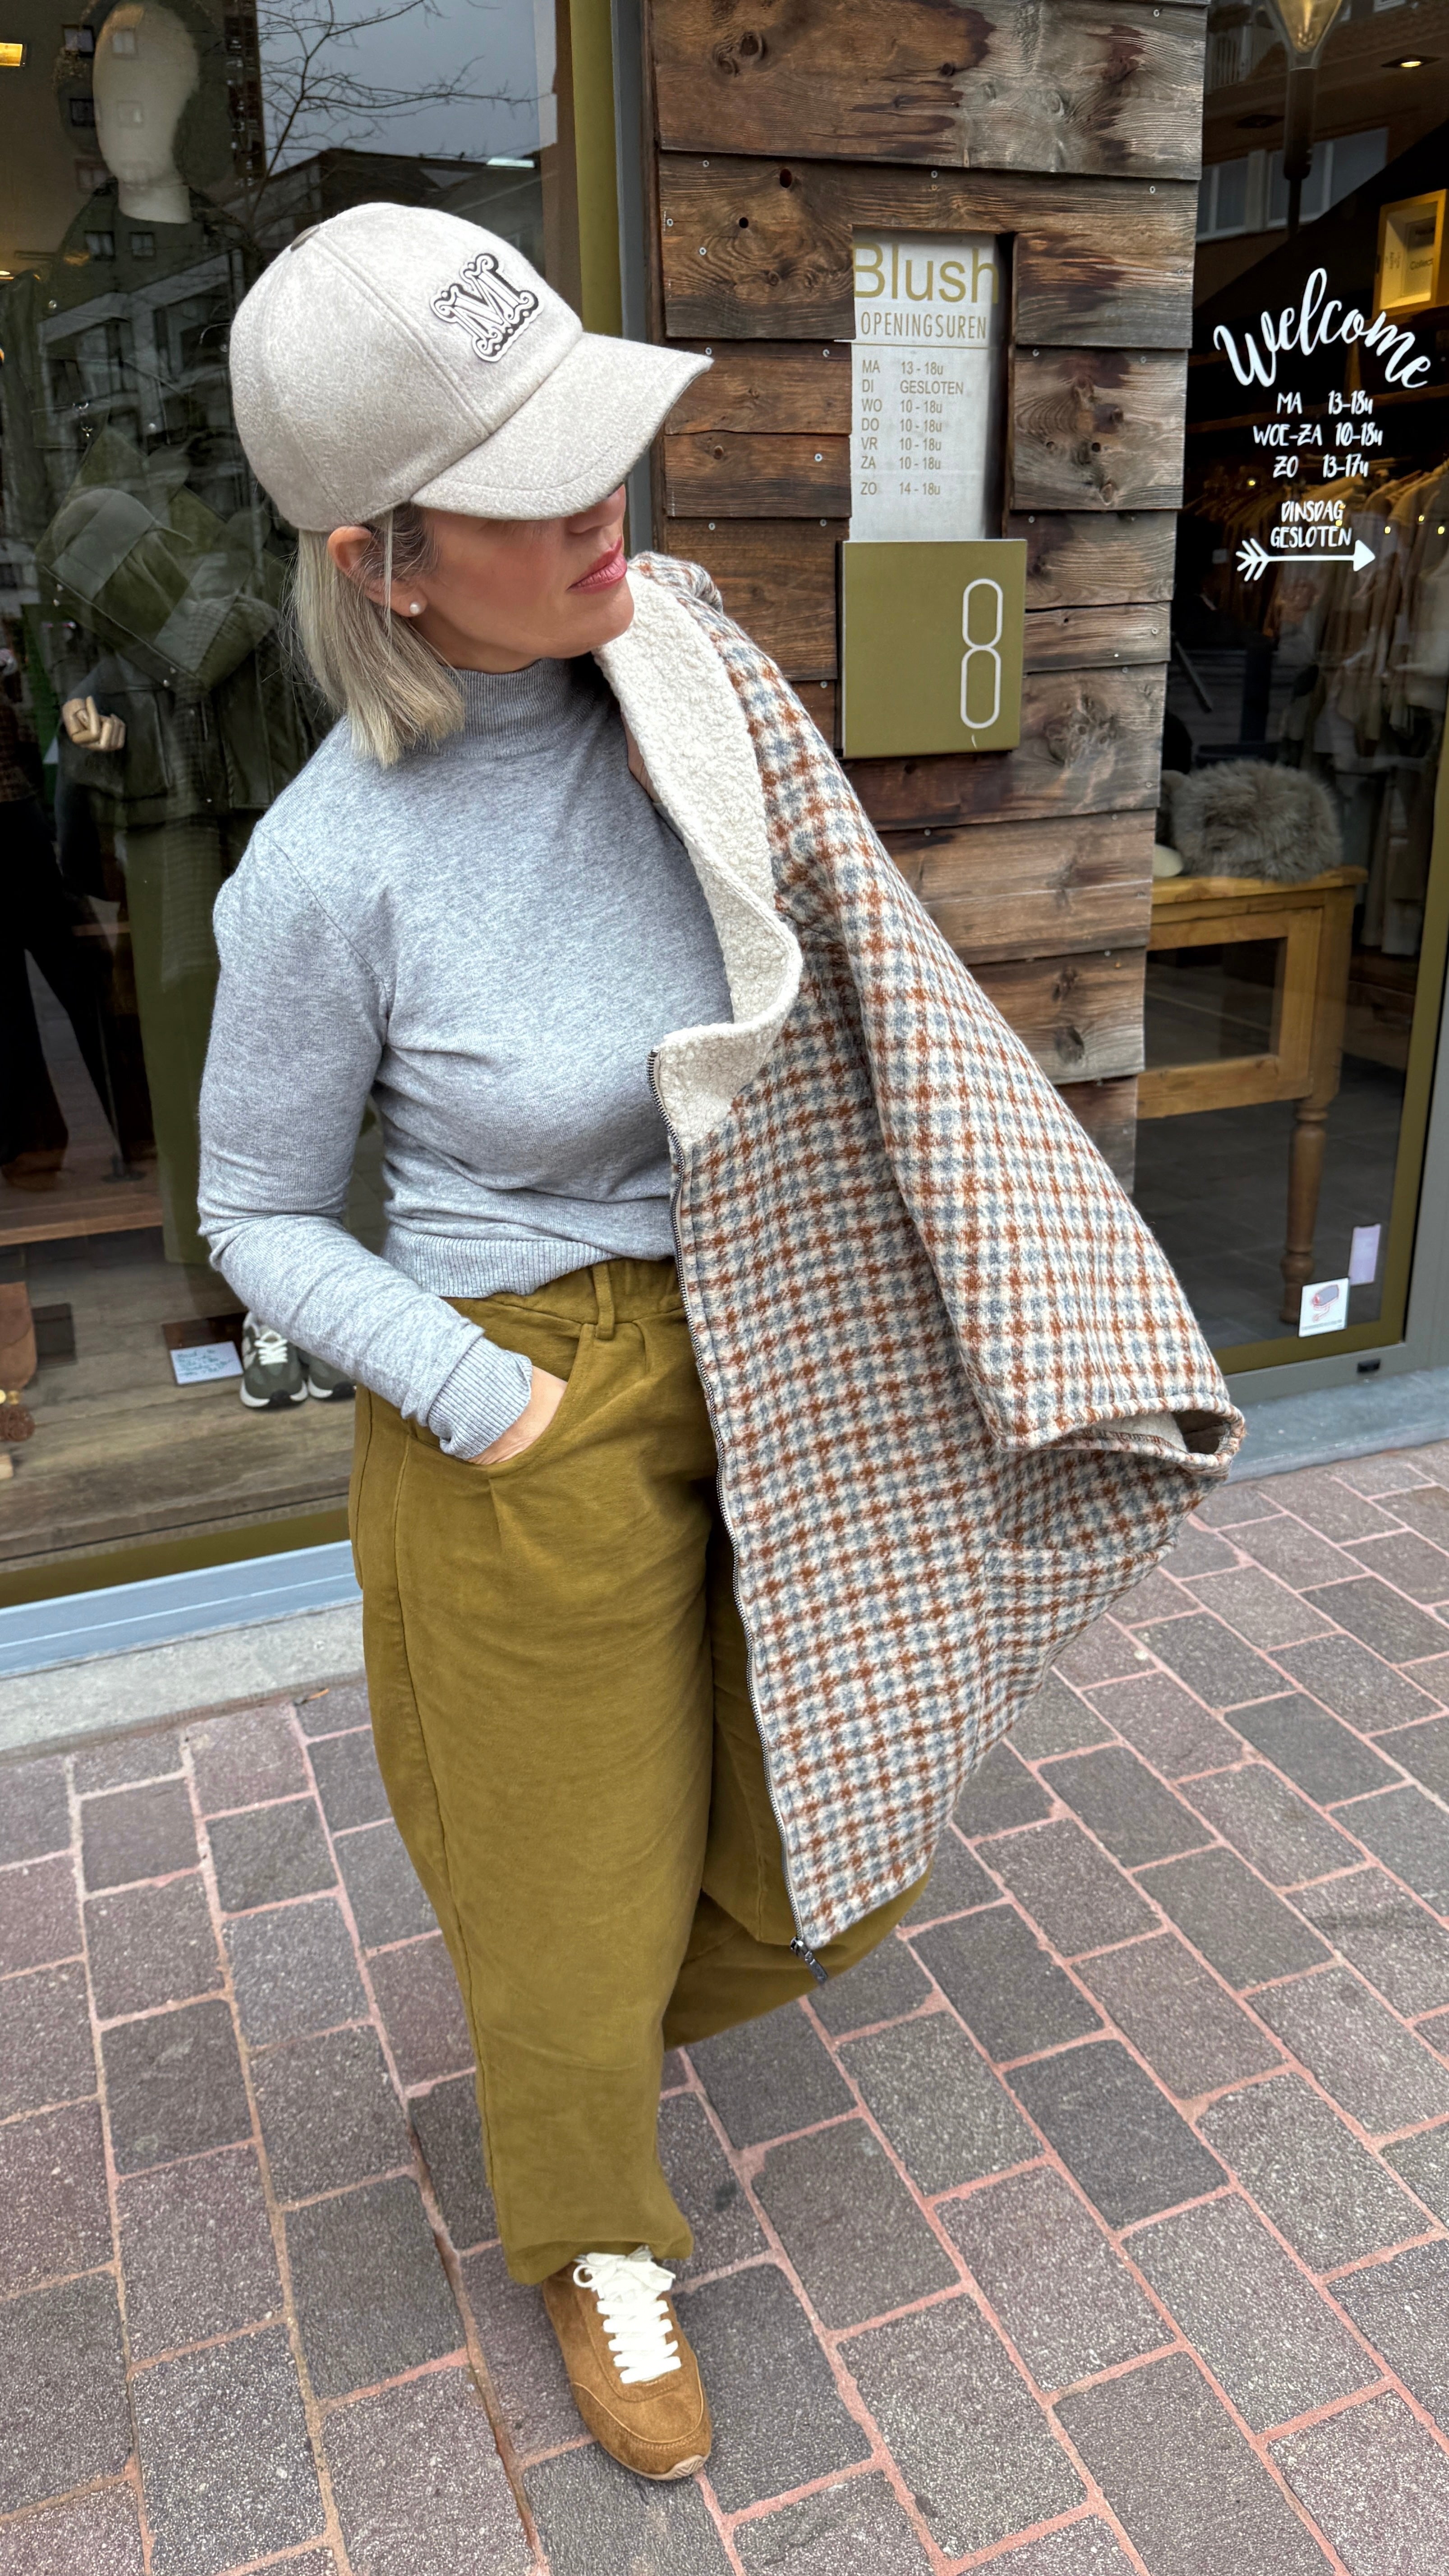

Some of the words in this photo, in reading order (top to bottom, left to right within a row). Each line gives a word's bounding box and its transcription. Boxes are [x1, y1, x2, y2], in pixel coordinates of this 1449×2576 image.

[852, 242, 999, 304] Blush
[433, 253, 539, 359] M
[860, 311, 986, 339] OPENINGSUREN
[1213, 268, 1431, 389] Welcome
[862, 359, 881, 374] MA
[901, 361, 914, 375] 13
[925, 362, 943, 375] 18u
[862, 379, 874, 393] DI
[900, 380, 964, 395] GESLOTEN
[861, 398, 883, 412] WO
[901, 399, 913, 413] 10
[925, 400, 943, 414] 18u
[1277, 391, 1303, 414] MA
[1329, 390, 1373, 414] 13-18u
[861, 418, 879, 431] DO
[900, 419, 912, 432] 10
[925, 419, 942, 433] 18u
[1253, 423, 1322, 446] WOE-ZA
[1336, 422, 1383, 446] 10-18u
[861, 437, 878, 450] VR
[900, 437, 912, 451] 10
[924, 437, 942, 451] 18u
[860, 455, 876, 469] ZA
[900, 456, 911, 470] 10
[924, 456, 941, 470] 18u
[1273, 455, 1299, 478] ZO
[1323, 453, 1369, 478] 13-17u
[860, 481, 878, 495] ZO
[900, 482, 911, 495] 14
[923, 482, 940, 495] 18u
[1281, 500, 1346, 522] DINSDAG
[1270, 526, 1352, 548] GESLOTEN
